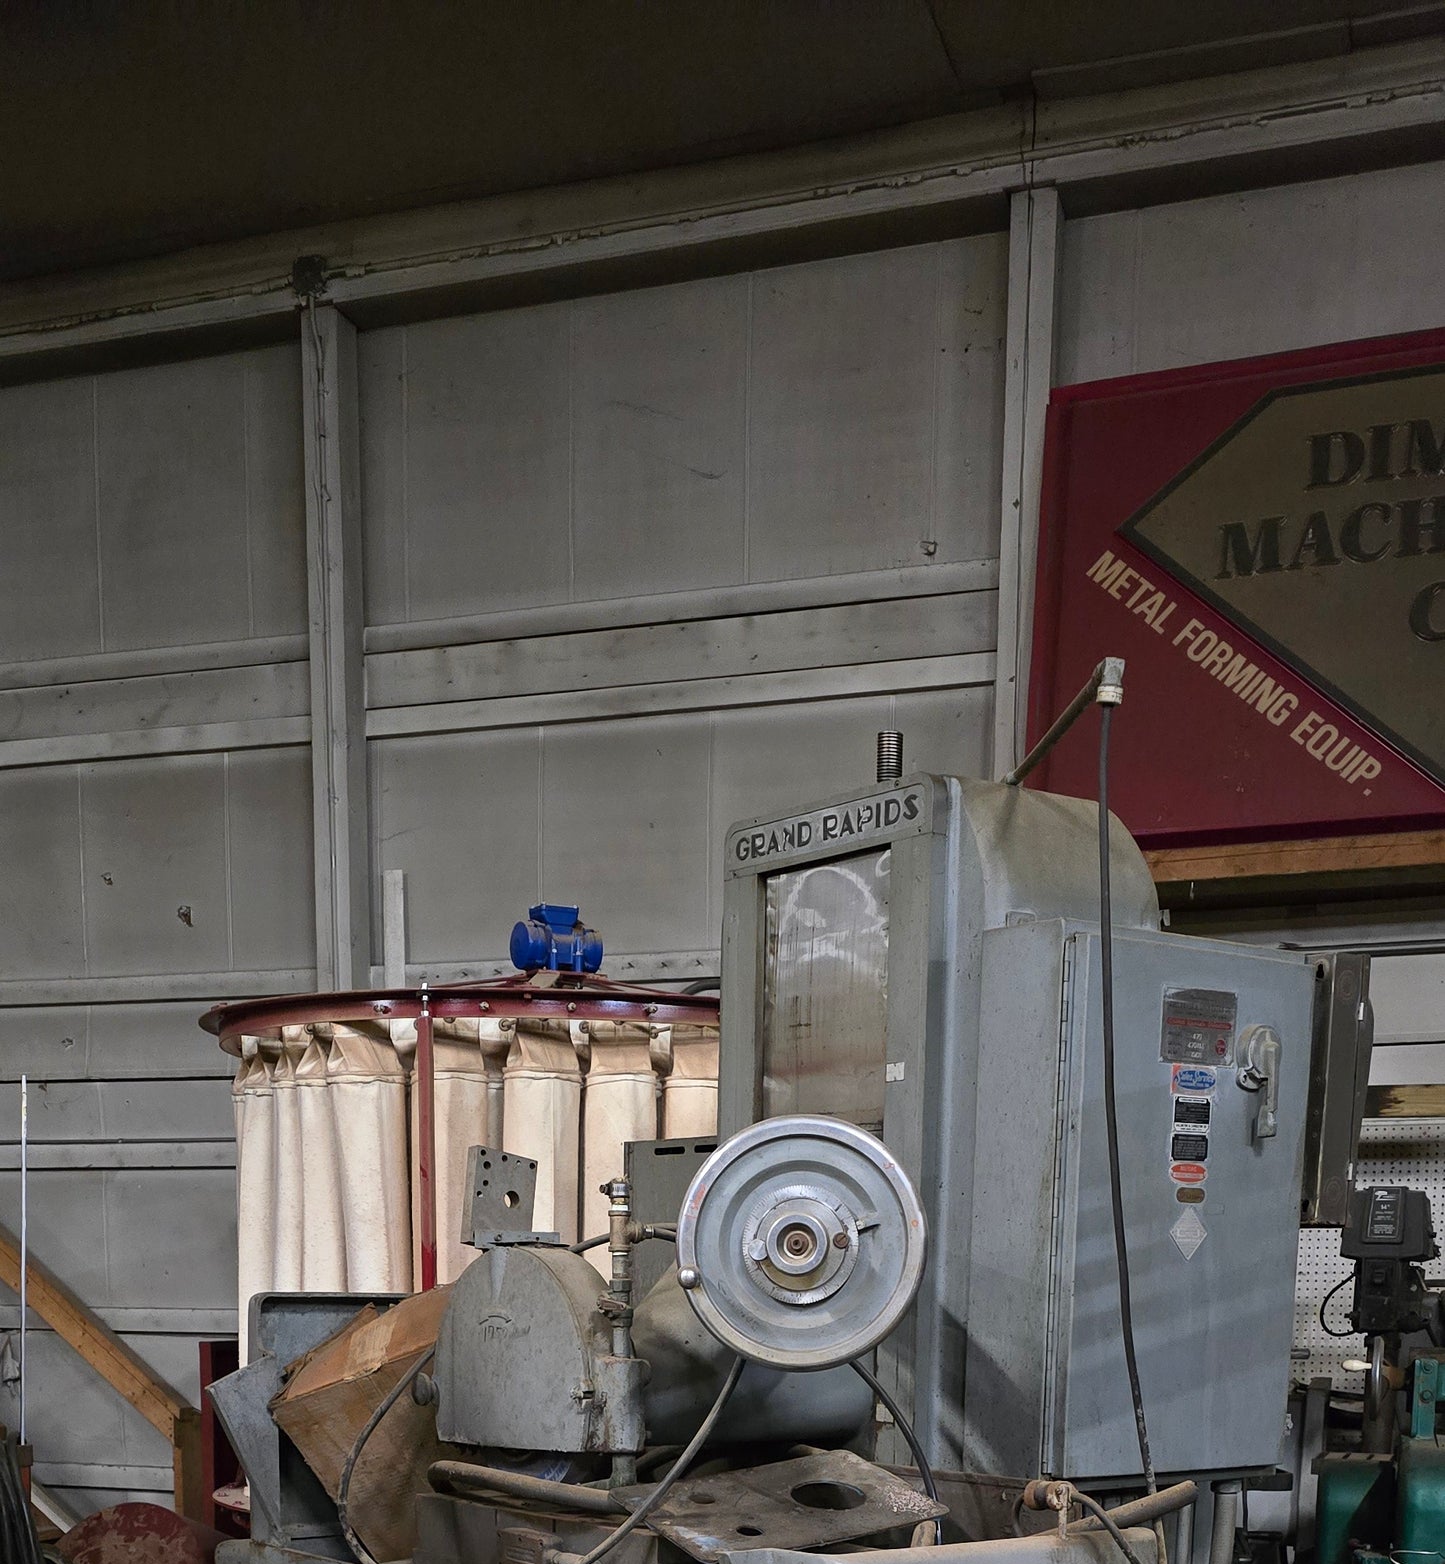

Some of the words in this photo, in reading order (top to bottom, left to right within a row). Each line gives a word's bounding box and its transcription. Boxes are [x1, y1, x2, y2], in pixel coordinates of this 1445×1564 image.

[1215, 496, 1445, 580] MACH
[1086, 549, 1179, 634] METAL
[1173, 618, 1300, 725] FORMING
[1289, 711, 1382, 797] EQUIP.
[735, 821, 812, 861] GRAND
[823, 794, 920, 841] RAPIDS
